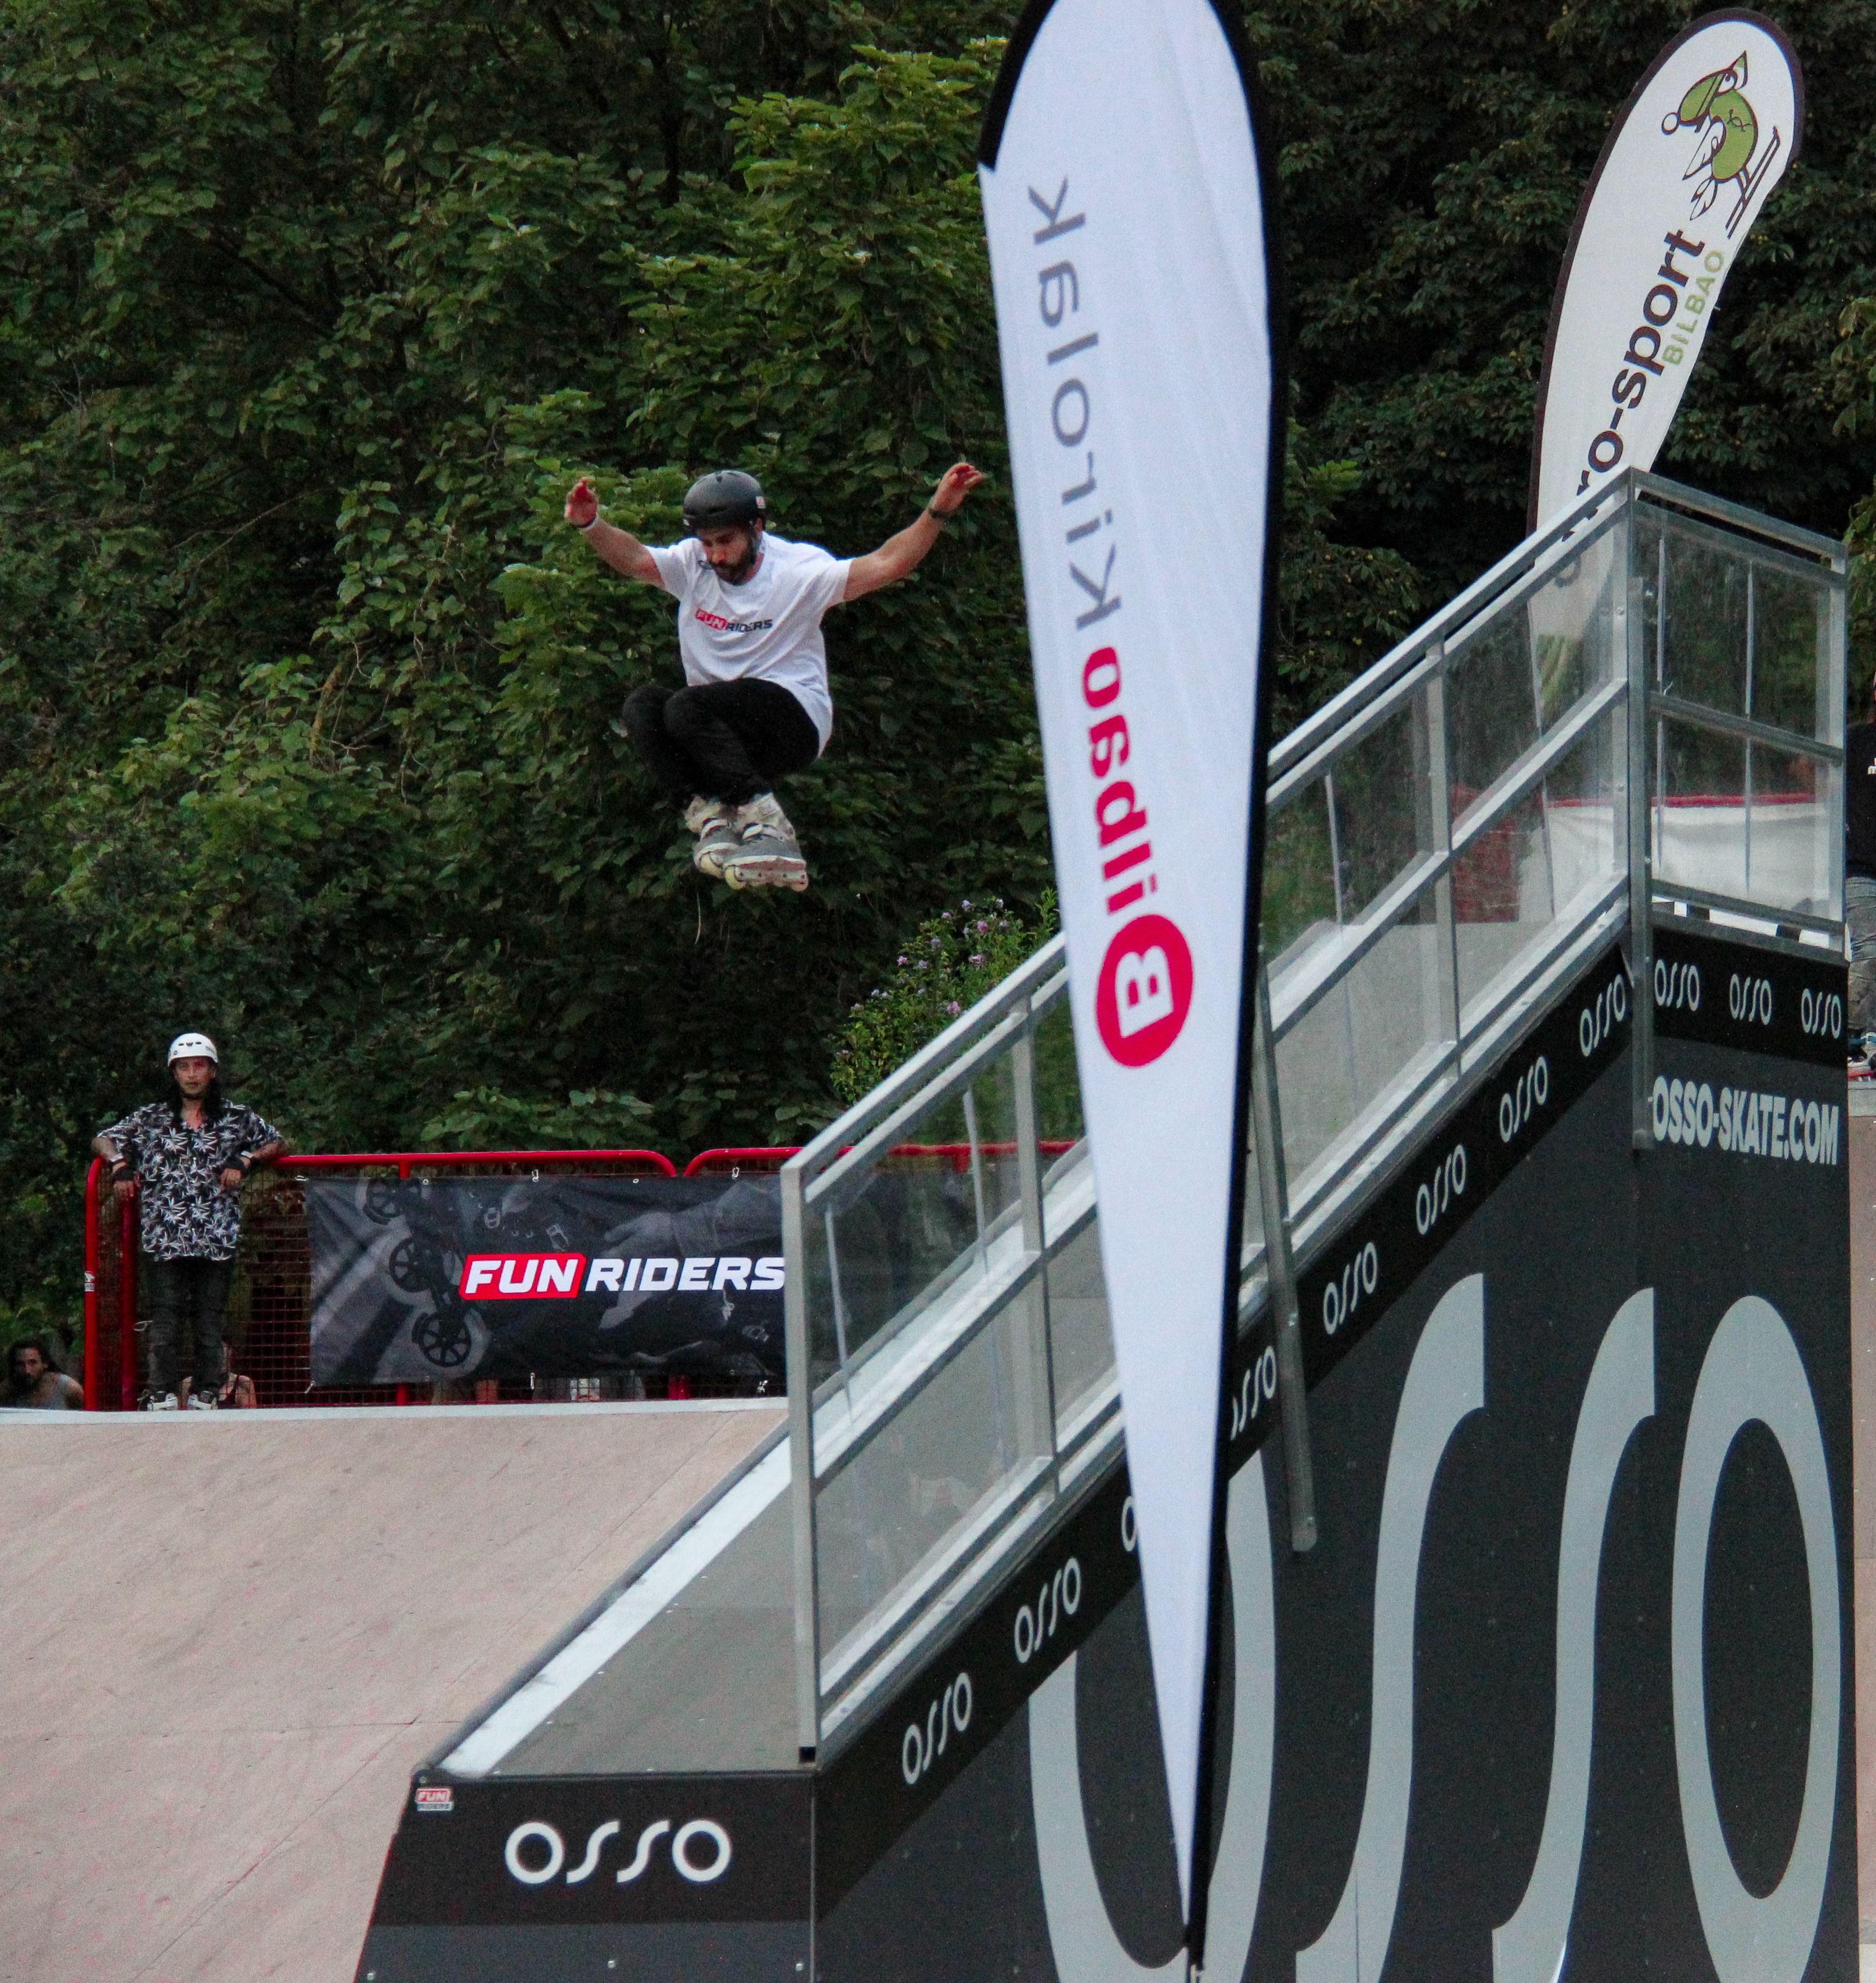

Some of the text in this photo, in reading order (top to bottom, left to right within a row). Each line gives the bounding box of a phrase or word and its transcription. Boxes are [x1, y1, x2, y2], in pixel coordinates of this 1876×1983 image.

[1662, 250, 1725, 366] BILBAO
[697, 611, 773, 632] FUN RIDERS
[1654, 959, 1841, 1039] OSSO OSSO OSSO
[1653, 1075, 1839, 1166] OSSO-SKATE.COM
[464, 1257, 785, 1294] FUN RIDERS
[902, 974, 1626, 1785] OSSO OSSO SSO OSSO OSSO OSSO OSSO
[504, 1818, 733, 1885] OSSO
